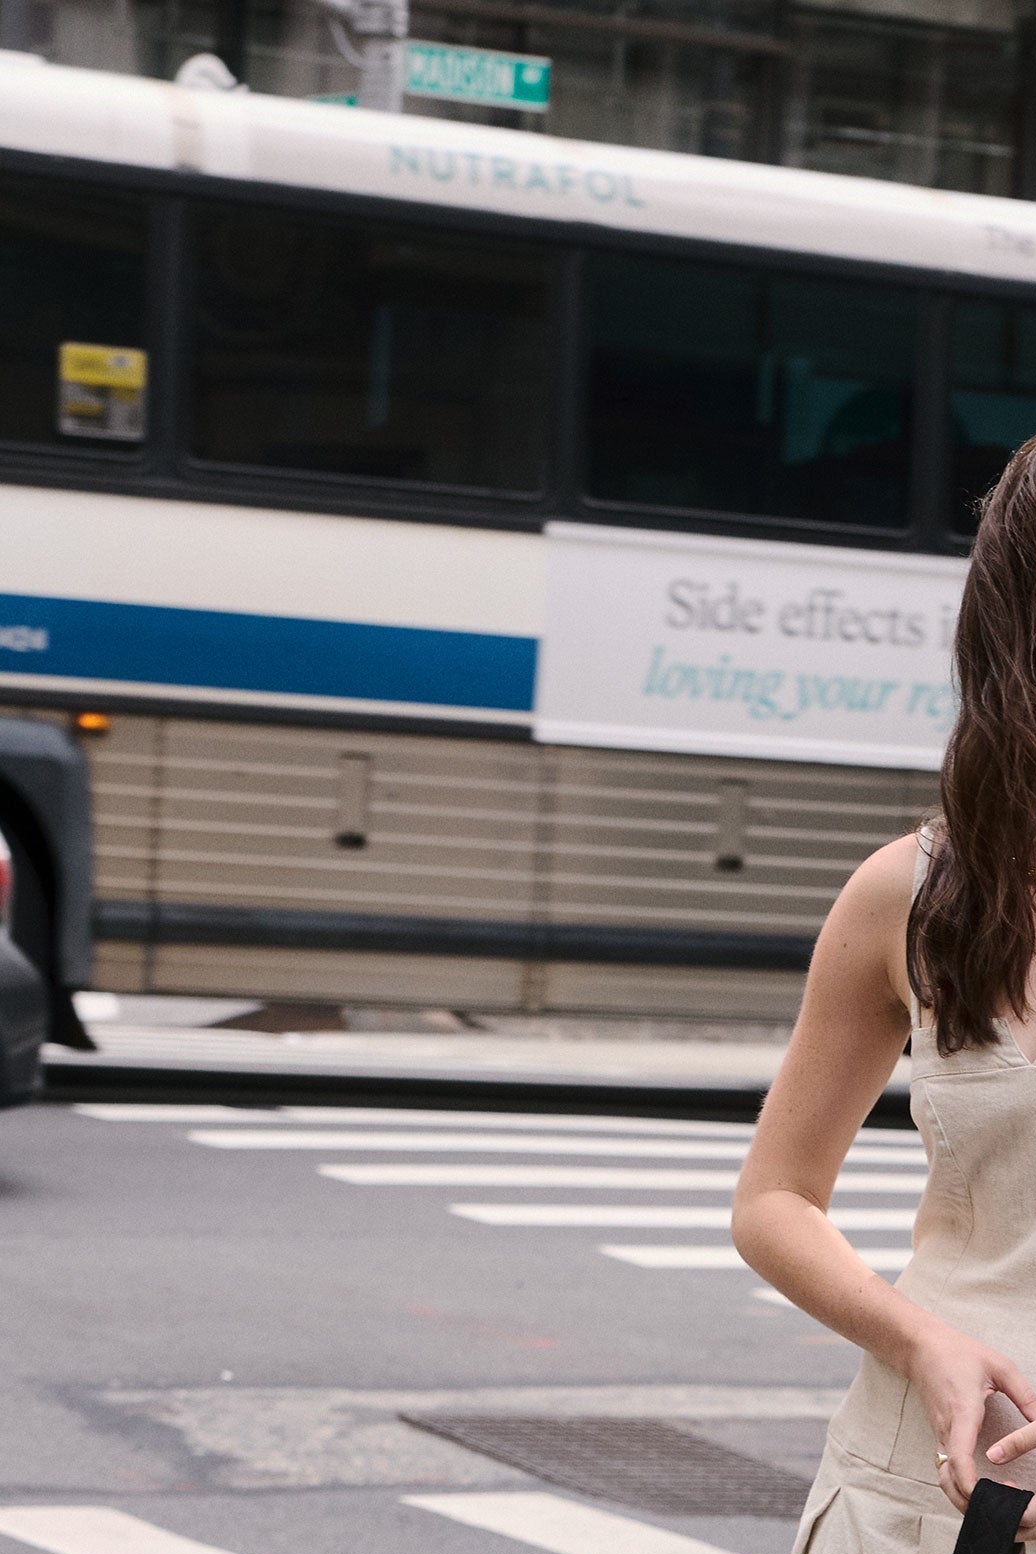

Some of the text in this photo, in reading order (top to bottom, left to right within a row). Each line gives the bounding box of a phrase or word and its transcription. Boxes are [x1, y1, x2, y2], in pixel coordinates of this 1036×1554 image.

[388, 144, 646, 207] NUTRAFOL
[665, 576, 764, 634] Side
[778, 587, 926, 648] effects
[642, 645, 784, 721] loving
[778, 673, 899, 722] your
